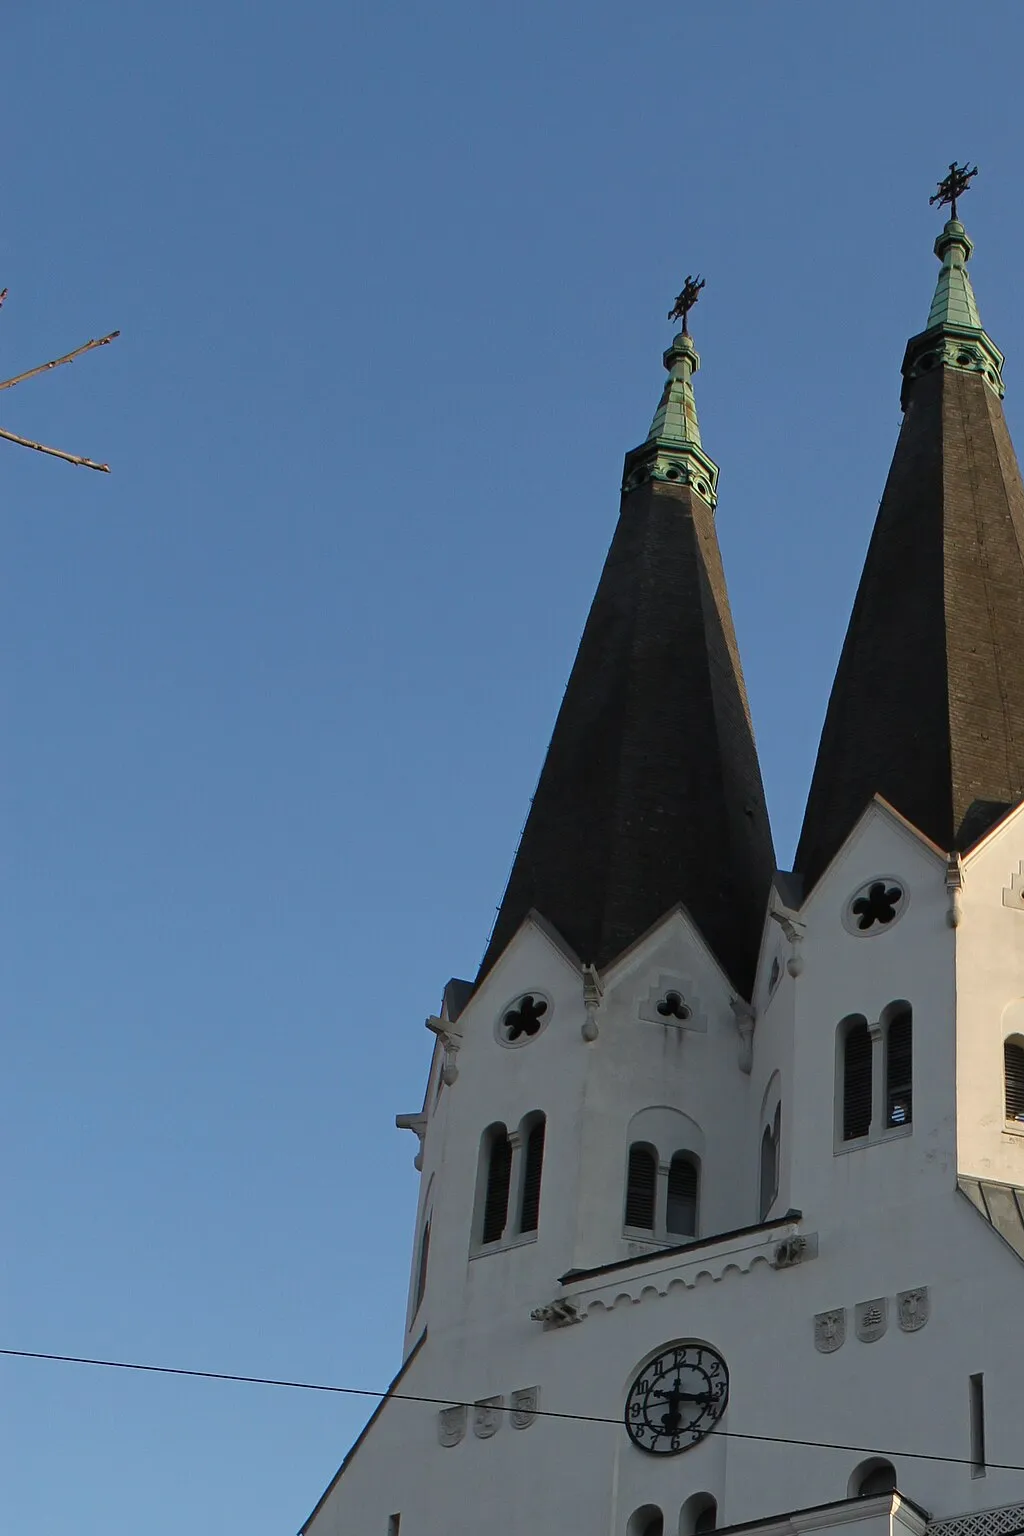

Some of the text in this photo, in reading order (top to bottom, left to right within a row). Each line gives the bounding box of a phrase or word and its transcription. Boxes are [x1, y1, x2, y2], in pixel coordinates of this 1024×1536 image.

[673, 1349, 687, 1367] 12
[697, 1350, 703, 1366] 1
[653, 1360, 663, 1376] 11
[711, 1362, 720, 1378] 2
[636, 1380, 649, 1396] 10
[715, 1382, 726, 1398] 3
[631, 1403, 641, 1418] 9
[706, 1403, 717, 1420] 4
[635, 1424, 645, 1438] 8
[691, 1424, 702, 1440] 5
[650, 1435, 658, 1451] 7
[671, 1435, 680, 1450] 6
